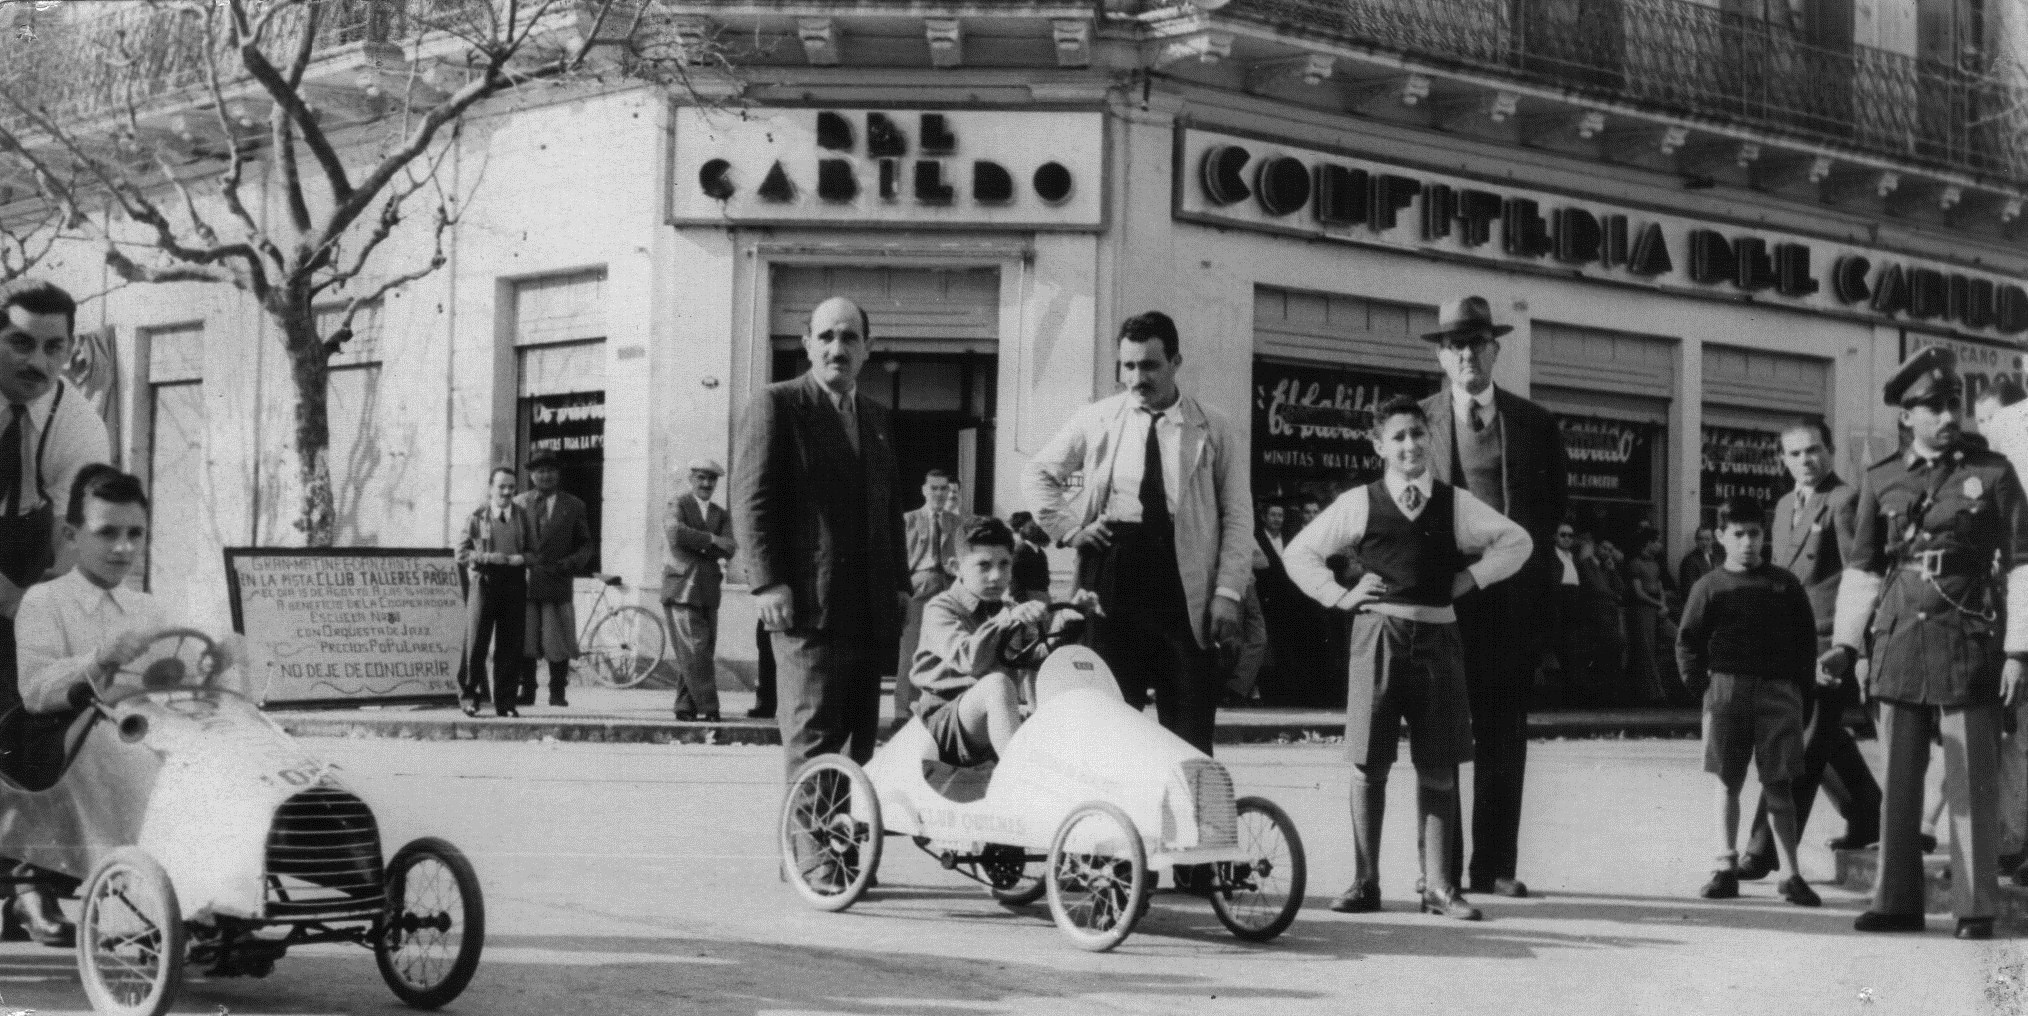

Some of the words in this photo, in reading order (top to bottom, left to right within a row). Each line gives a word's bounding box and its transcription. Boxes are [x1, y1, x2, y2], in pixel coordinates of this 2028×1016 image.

[817, 111, 957, 157] DEL
[699, 157, 1073, 206] CABILDO
[1202, 145, 1673, 277] CONFITERIA
[1690, 210, 1819, 296] DEL
[260, 572, 277, 588] LA
[315, 570, 355, 587] CLUB
[360, 569, 421, 587] TALLERES
[281, 663, 302, 679] NO
[306, 662, 340, 679] DEJE
[345, 662, 364, 679] DE
[364, 659, 451, 678] CONCURRIR
